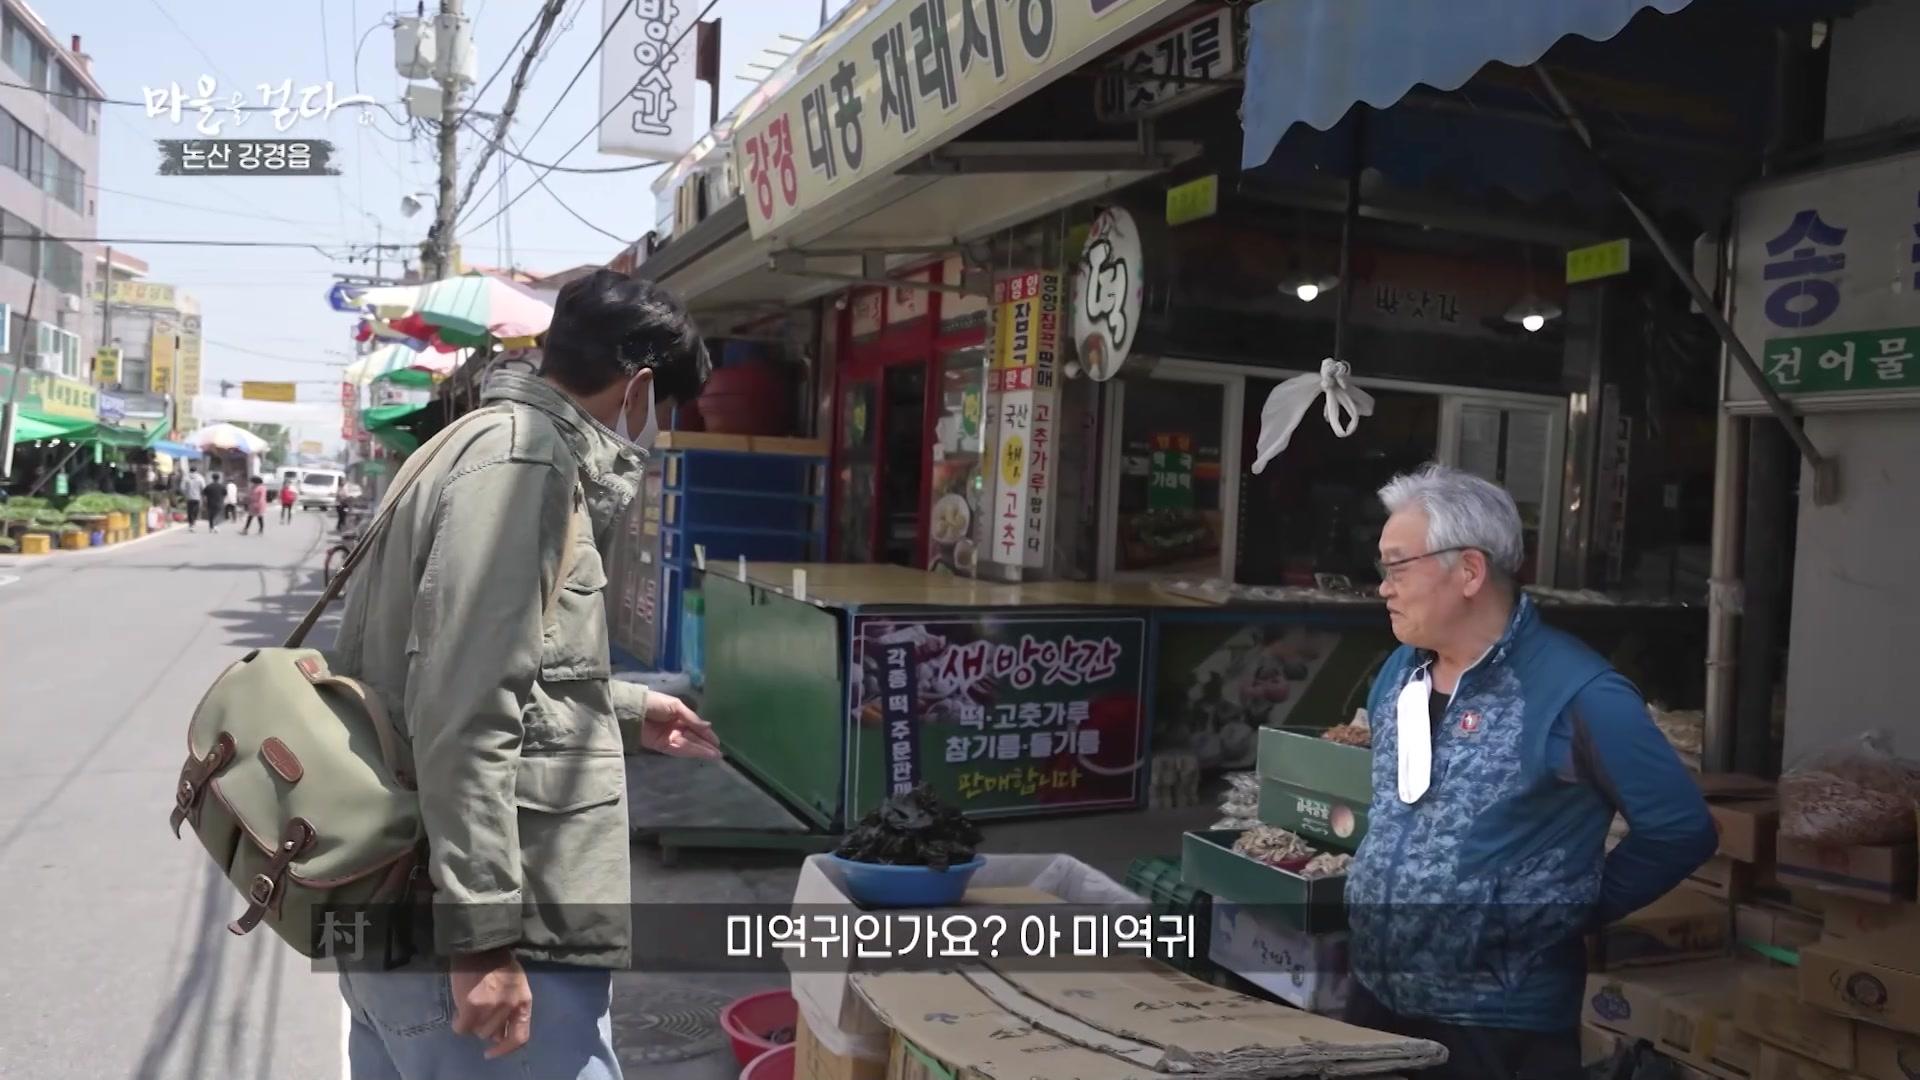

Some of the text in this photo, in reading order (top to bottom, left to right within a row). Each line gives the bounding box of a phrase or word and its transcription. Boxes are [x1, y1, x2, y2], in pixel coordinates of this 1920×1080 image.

[745, 112, 798, 221] 강경
[801, 60, 863, 180] 대흥
[1086, 239, 1128, 351] 떡
[1768, 337, 1915, 386] 건어물
[1003, 404, 1029, 429] 국산
[1001, 492, 1019, 556] 고추
[887, 648, 908, 689] 각종
[940, 634, 1122, 692] 새 방앗간
[888, 696, 909, 714] 떡
[957, 767, 1084, 799] 판매합니다
